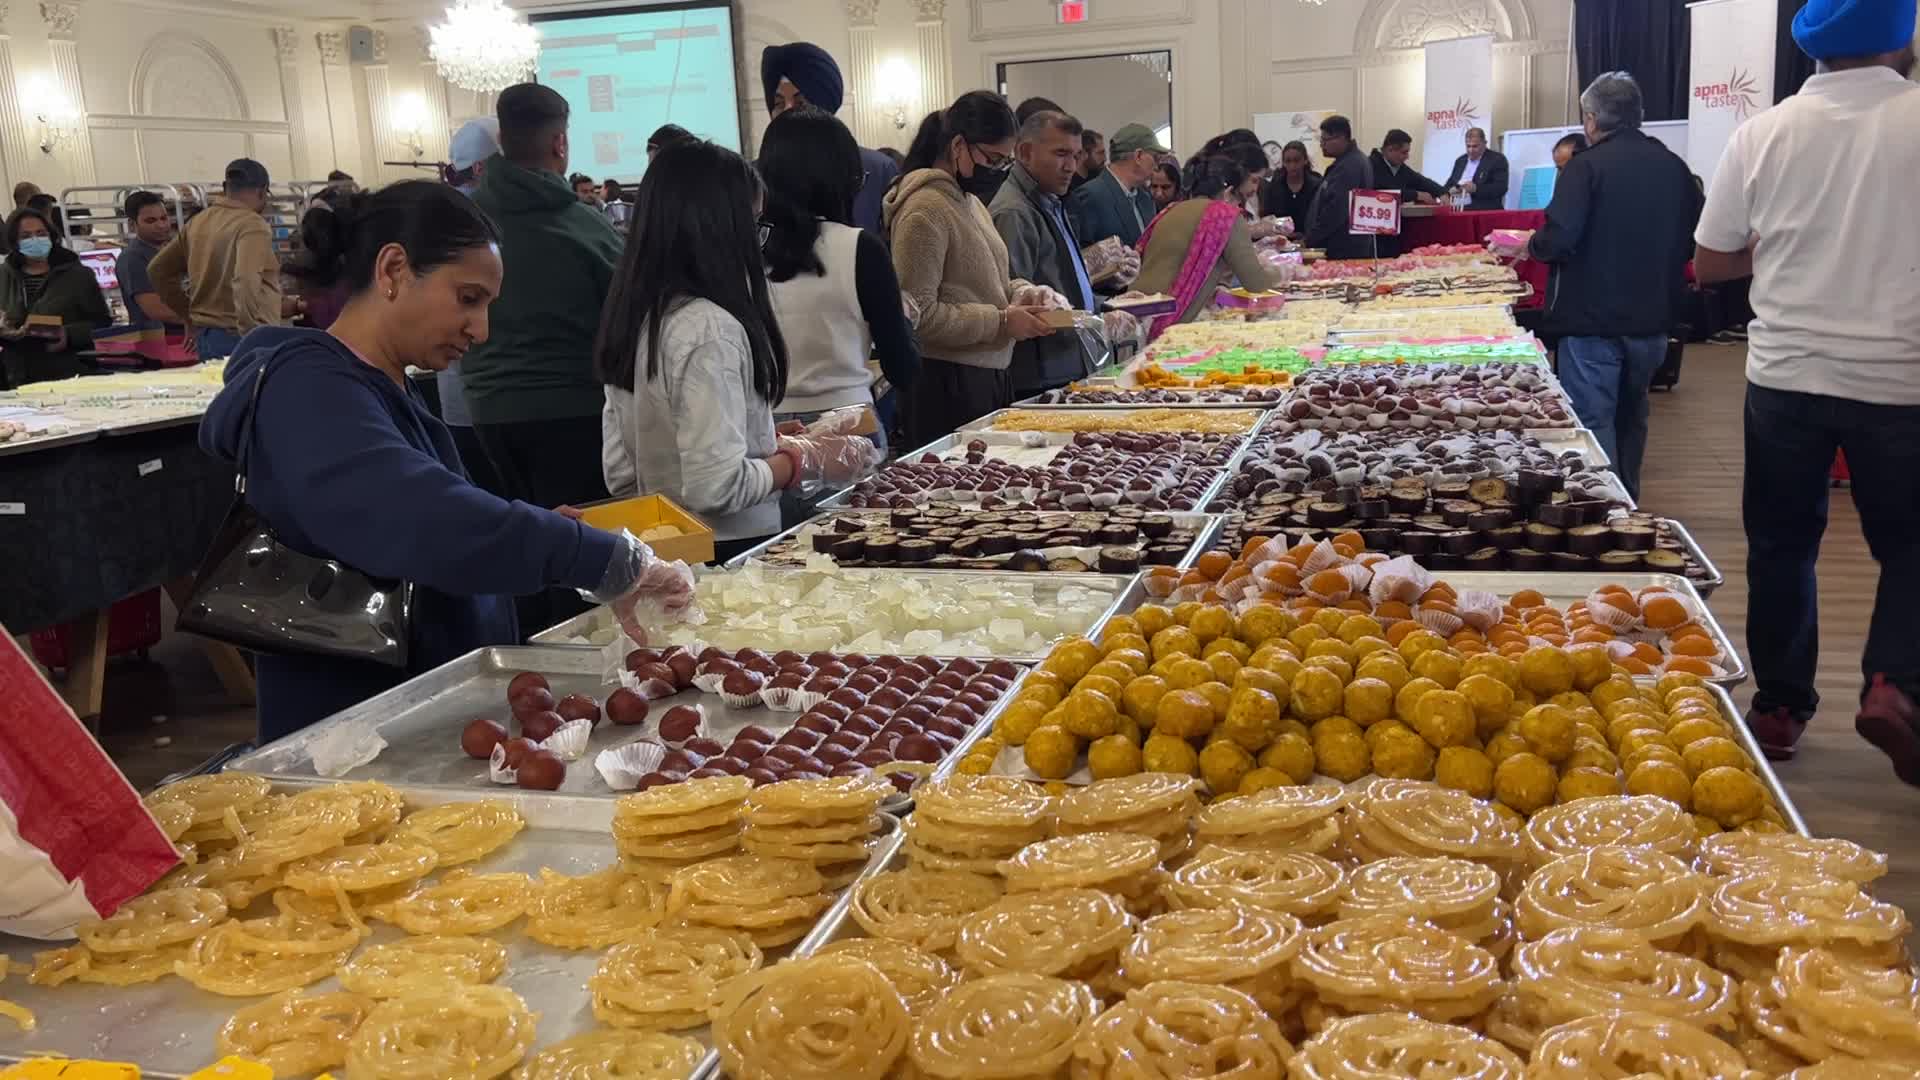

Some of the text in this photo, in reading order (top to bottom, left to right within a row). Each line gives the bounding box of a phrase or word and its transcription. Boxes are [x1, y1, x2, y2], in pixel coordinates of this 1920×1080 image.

[1695, 84, 1728, 99] apna
[1705, 94, 1738, 108] taste
[1427, 111, 1455, 123] apna
[1436, 120, 1464, 129] taste
[1359, 205, 1392, 220] $5.99
